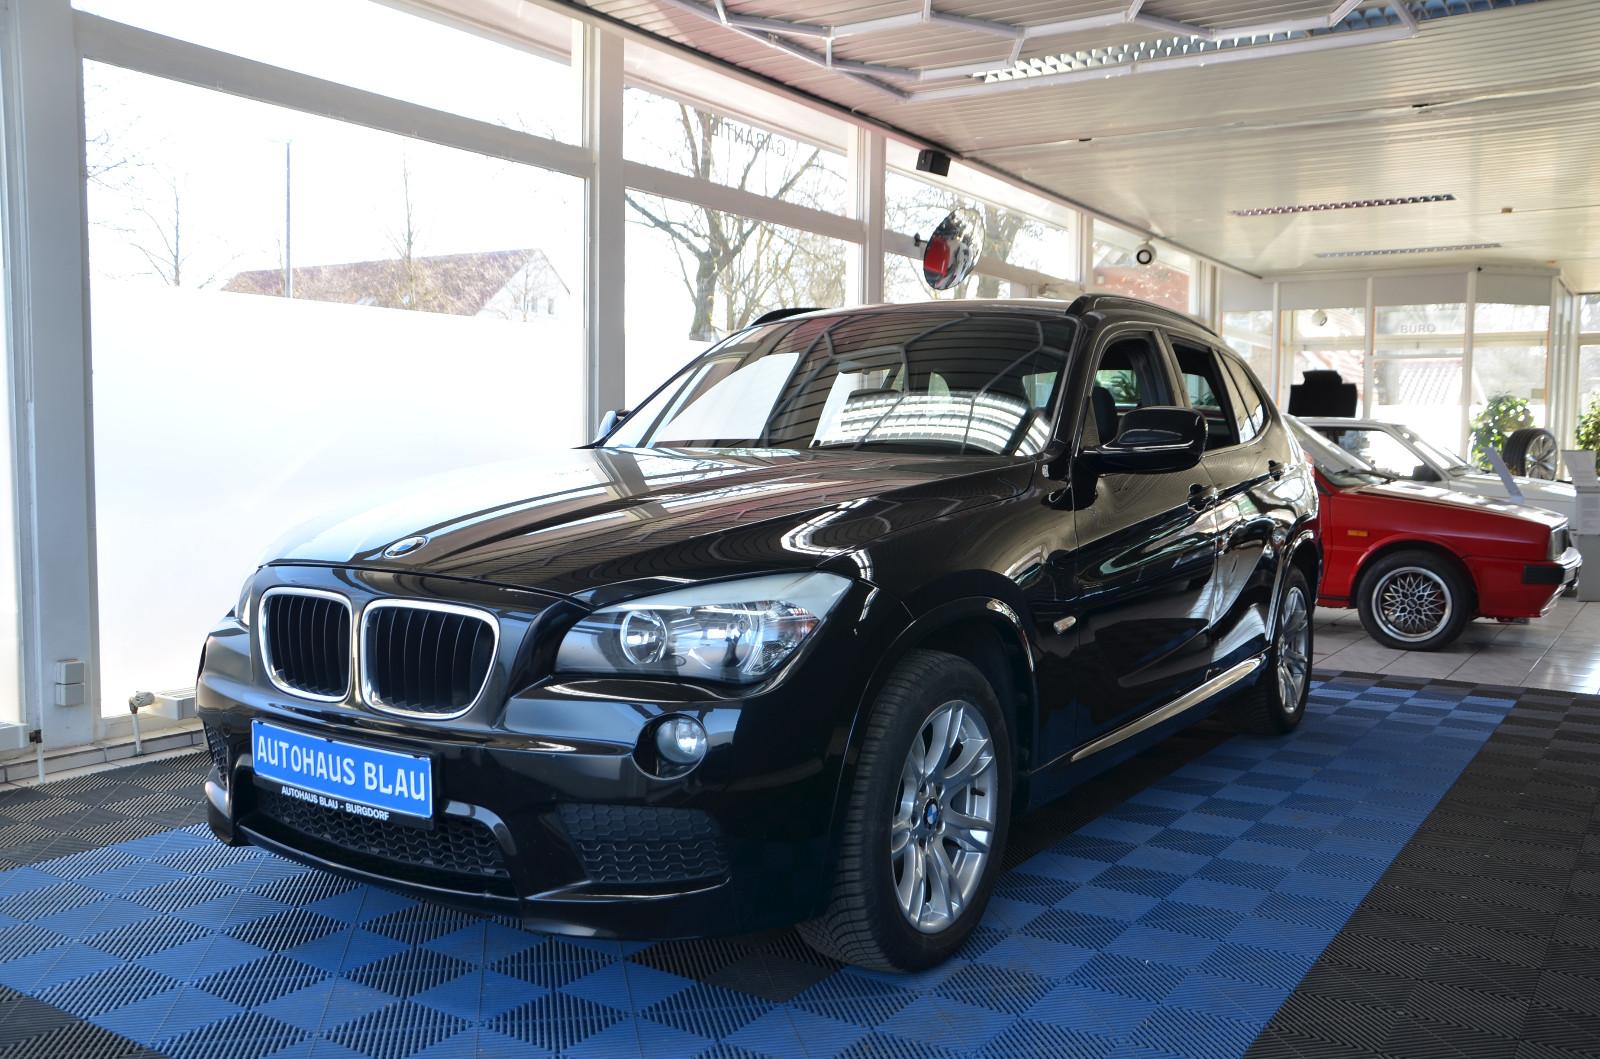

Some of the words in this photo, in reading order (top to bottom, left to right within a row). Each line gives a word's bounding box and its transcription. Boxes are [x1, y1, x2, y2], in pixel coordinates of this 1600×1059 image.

[257, 735, 356, 786] AUTOHAUS
[364, 762, 425, 801] BLAU
[281, 785, 318, 804] AUTOHAUS
[319, 796, 338, 810] BLAU
[346, 803, 390, 821] BURGDORF
